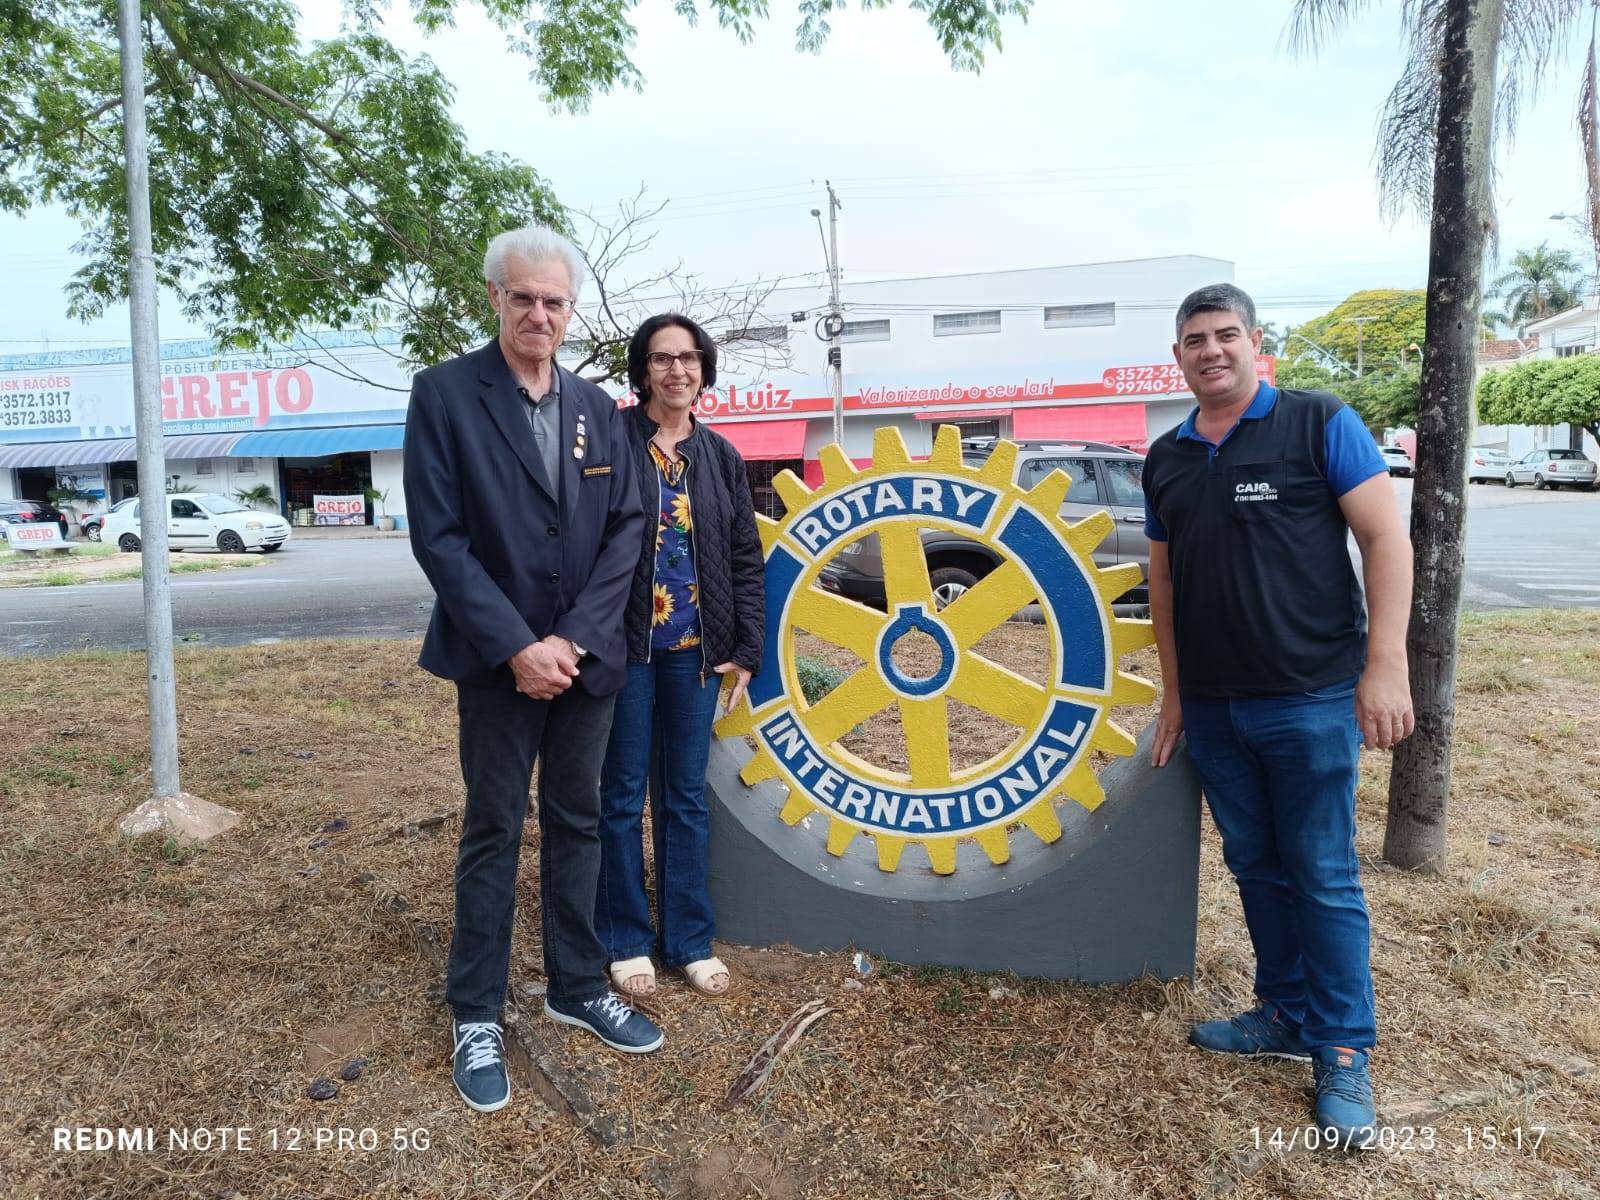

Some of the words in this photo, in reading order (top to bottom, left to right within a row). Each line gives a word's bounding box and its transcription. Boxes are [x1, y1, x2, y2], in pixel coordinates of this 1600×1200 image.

[729, 383, 793, 412] Luiz
[859, 383, 963, 404] Valorizando
[969, 385, 981, 398] o
[986, 384, 1017, 397] seu
[1023, 377, 1054, 396] lar!
[317, 501, 362, 513] GREJO
[795, 479, 985, 551] ROTARY
[17, 528, 54, 540] GREJO
[766, 717, 1087, 830] INTERNATIONAL
